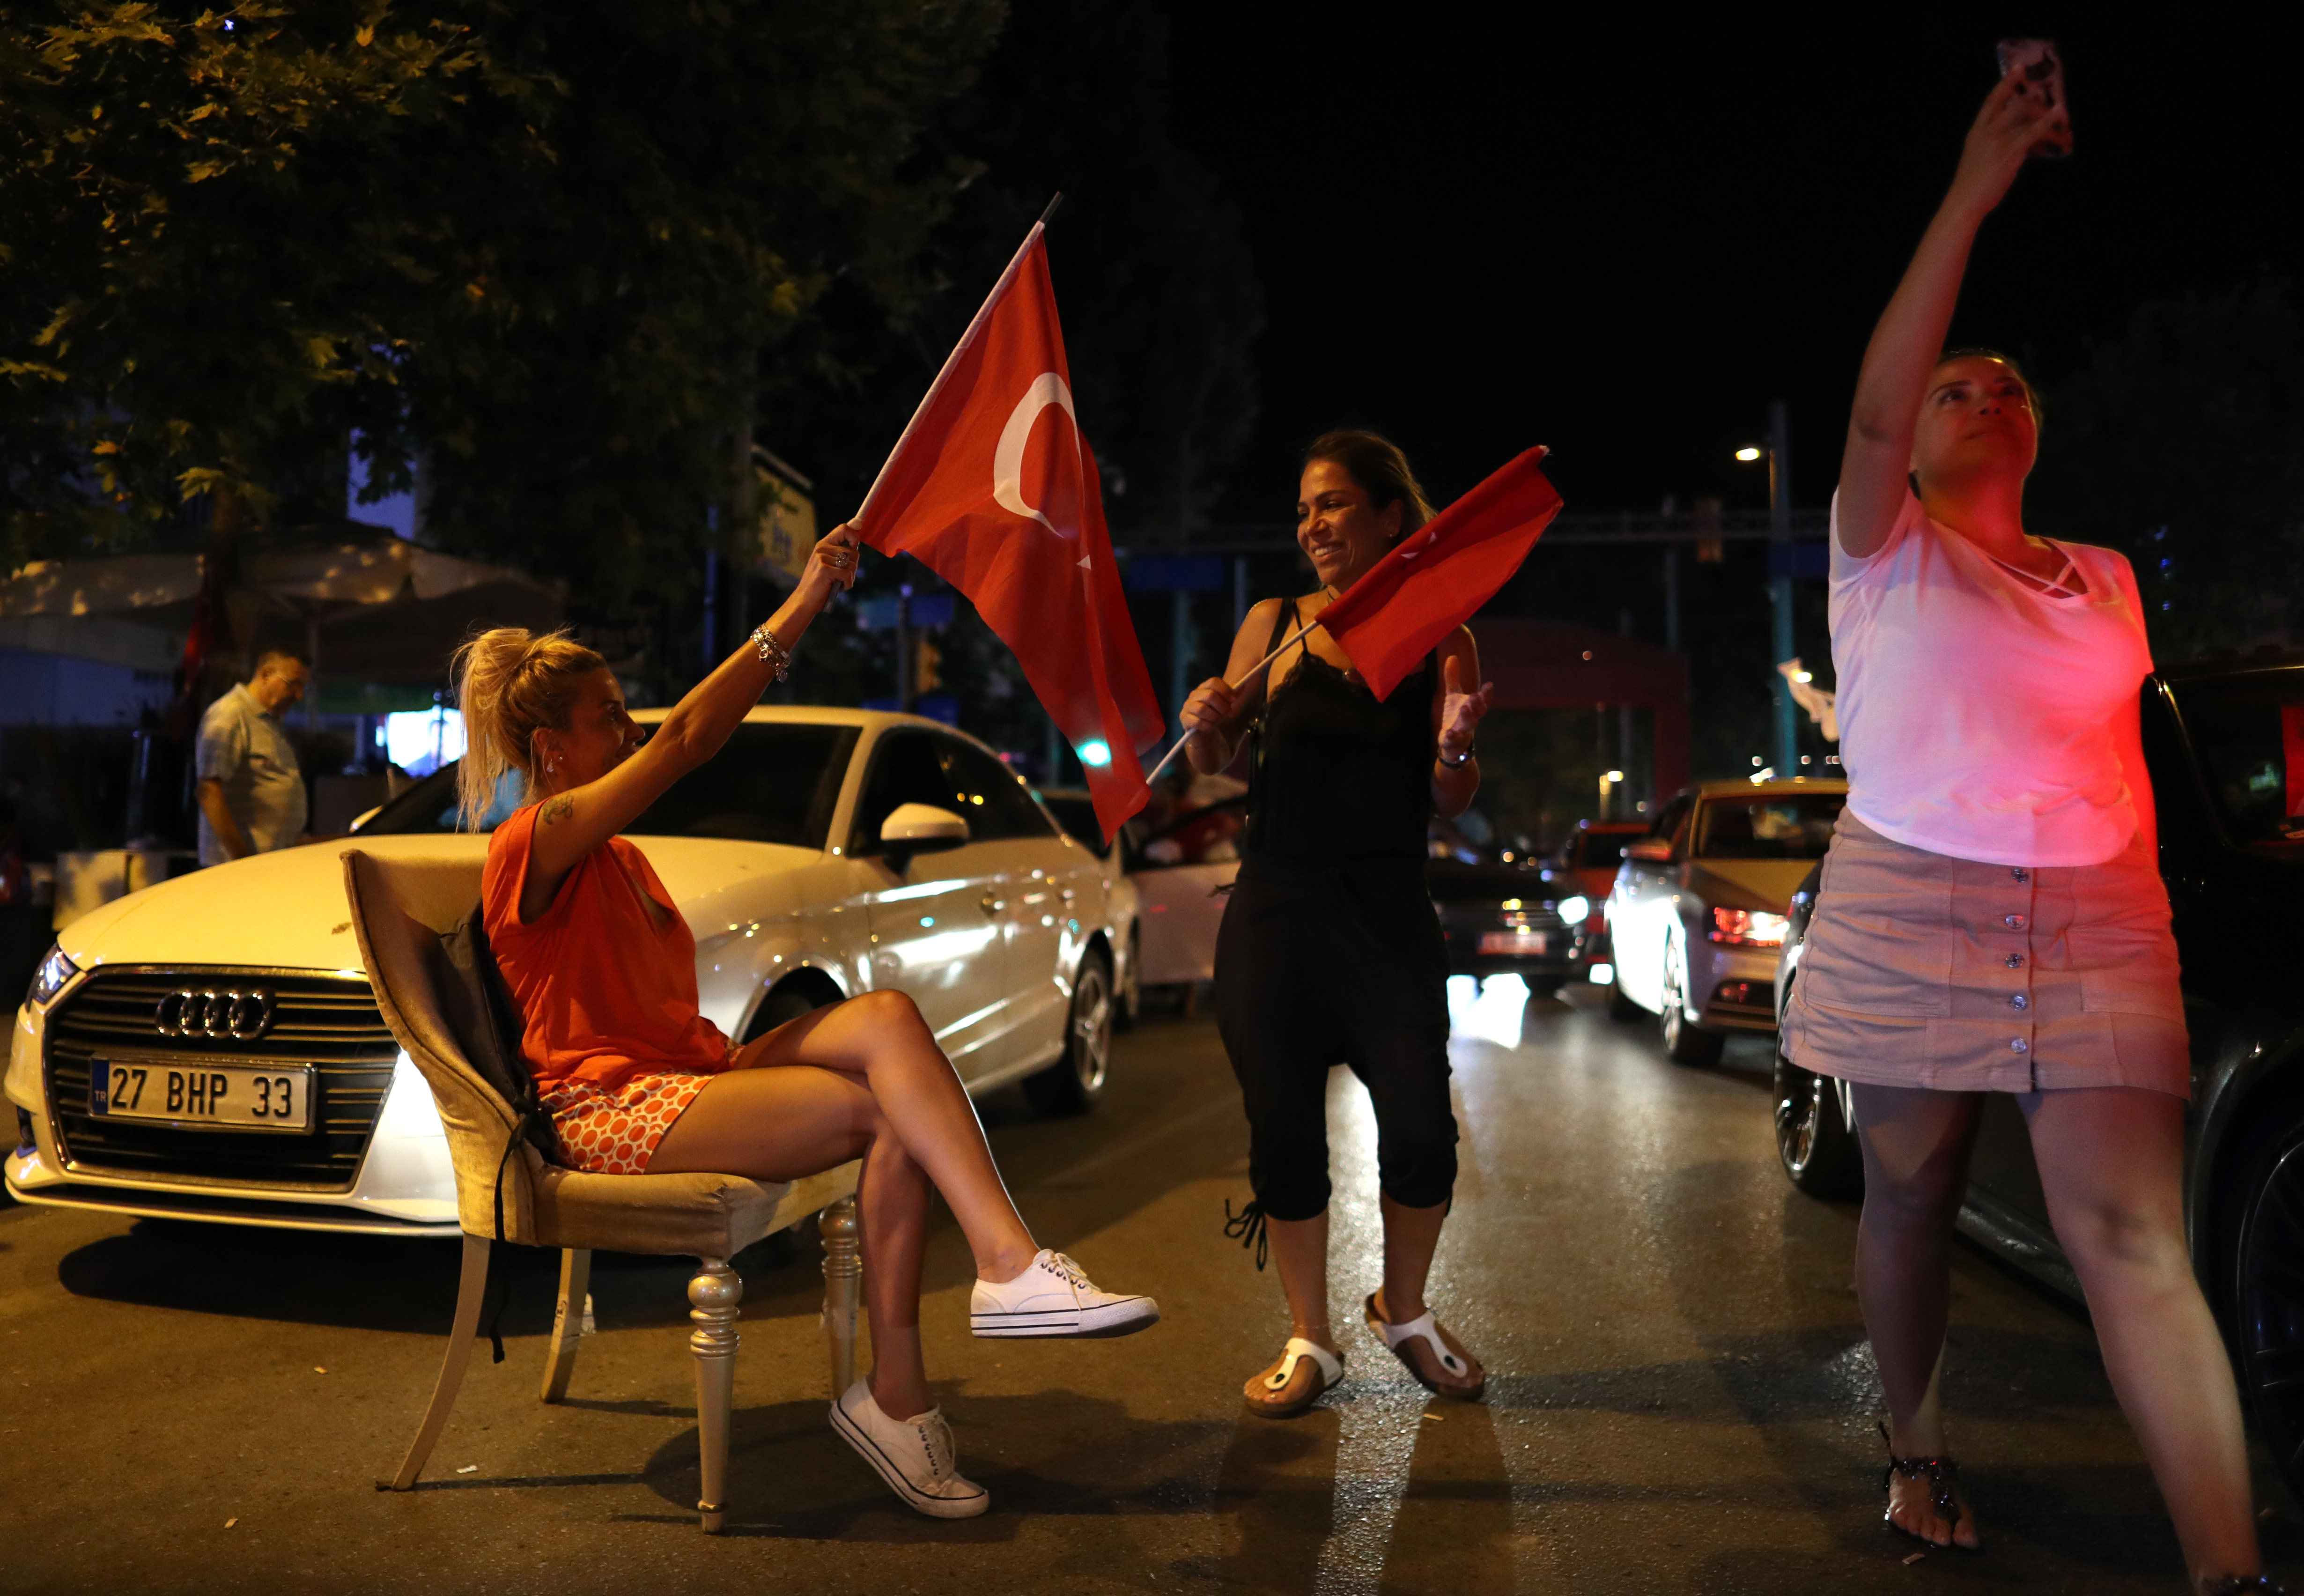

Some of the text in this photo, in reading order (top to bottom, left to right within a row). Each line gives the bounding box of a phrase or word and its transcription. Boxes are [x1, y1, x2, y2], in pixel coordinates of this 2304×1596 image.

[94, 1090, 107, 1102] TR
[112, 1068, 292, 1118] 27 BHP 33
